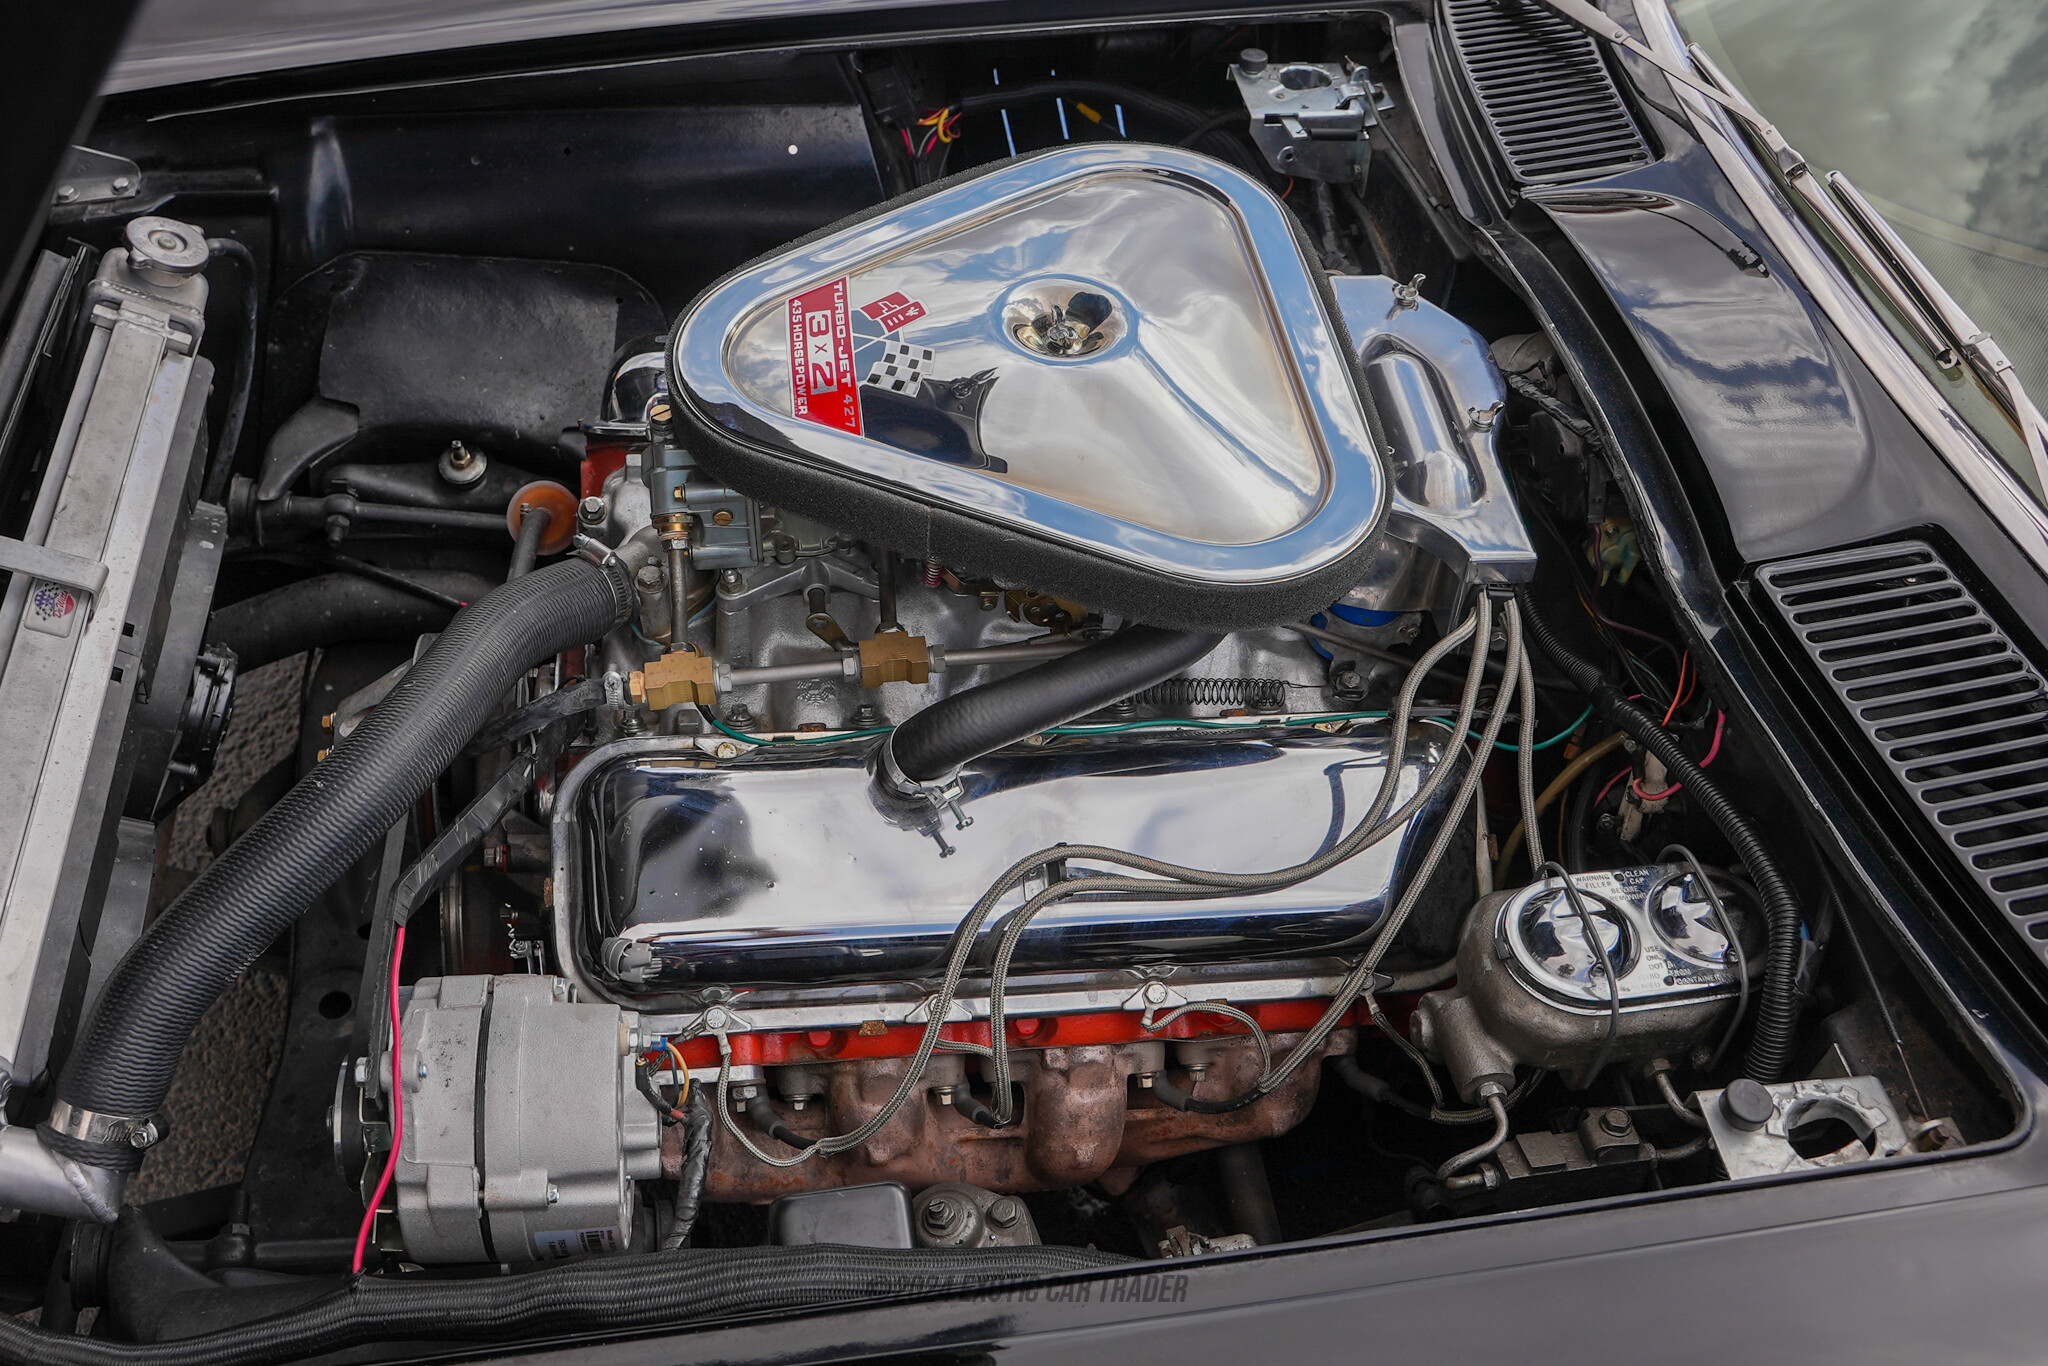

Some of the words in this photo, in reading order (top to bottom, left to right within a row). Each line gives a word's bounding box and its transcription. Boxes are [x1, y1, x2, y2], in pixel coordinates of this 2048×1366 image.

[833, 281, 852, 388] TURBO-JET
[843, 394, 856, 427] 427
[1574, 873, 1611, 883] WARNING
[1624, 869, 1650, 878] CLEAN
[1584, 880, 1612, 889] FILLER
[1629, 877, 1645, 885] CAP
[1644, 945, 1660, 953] USE
[1648, 962, 1664, 971] DOT
[1676, 973, 1721, 985] CONTAINER
